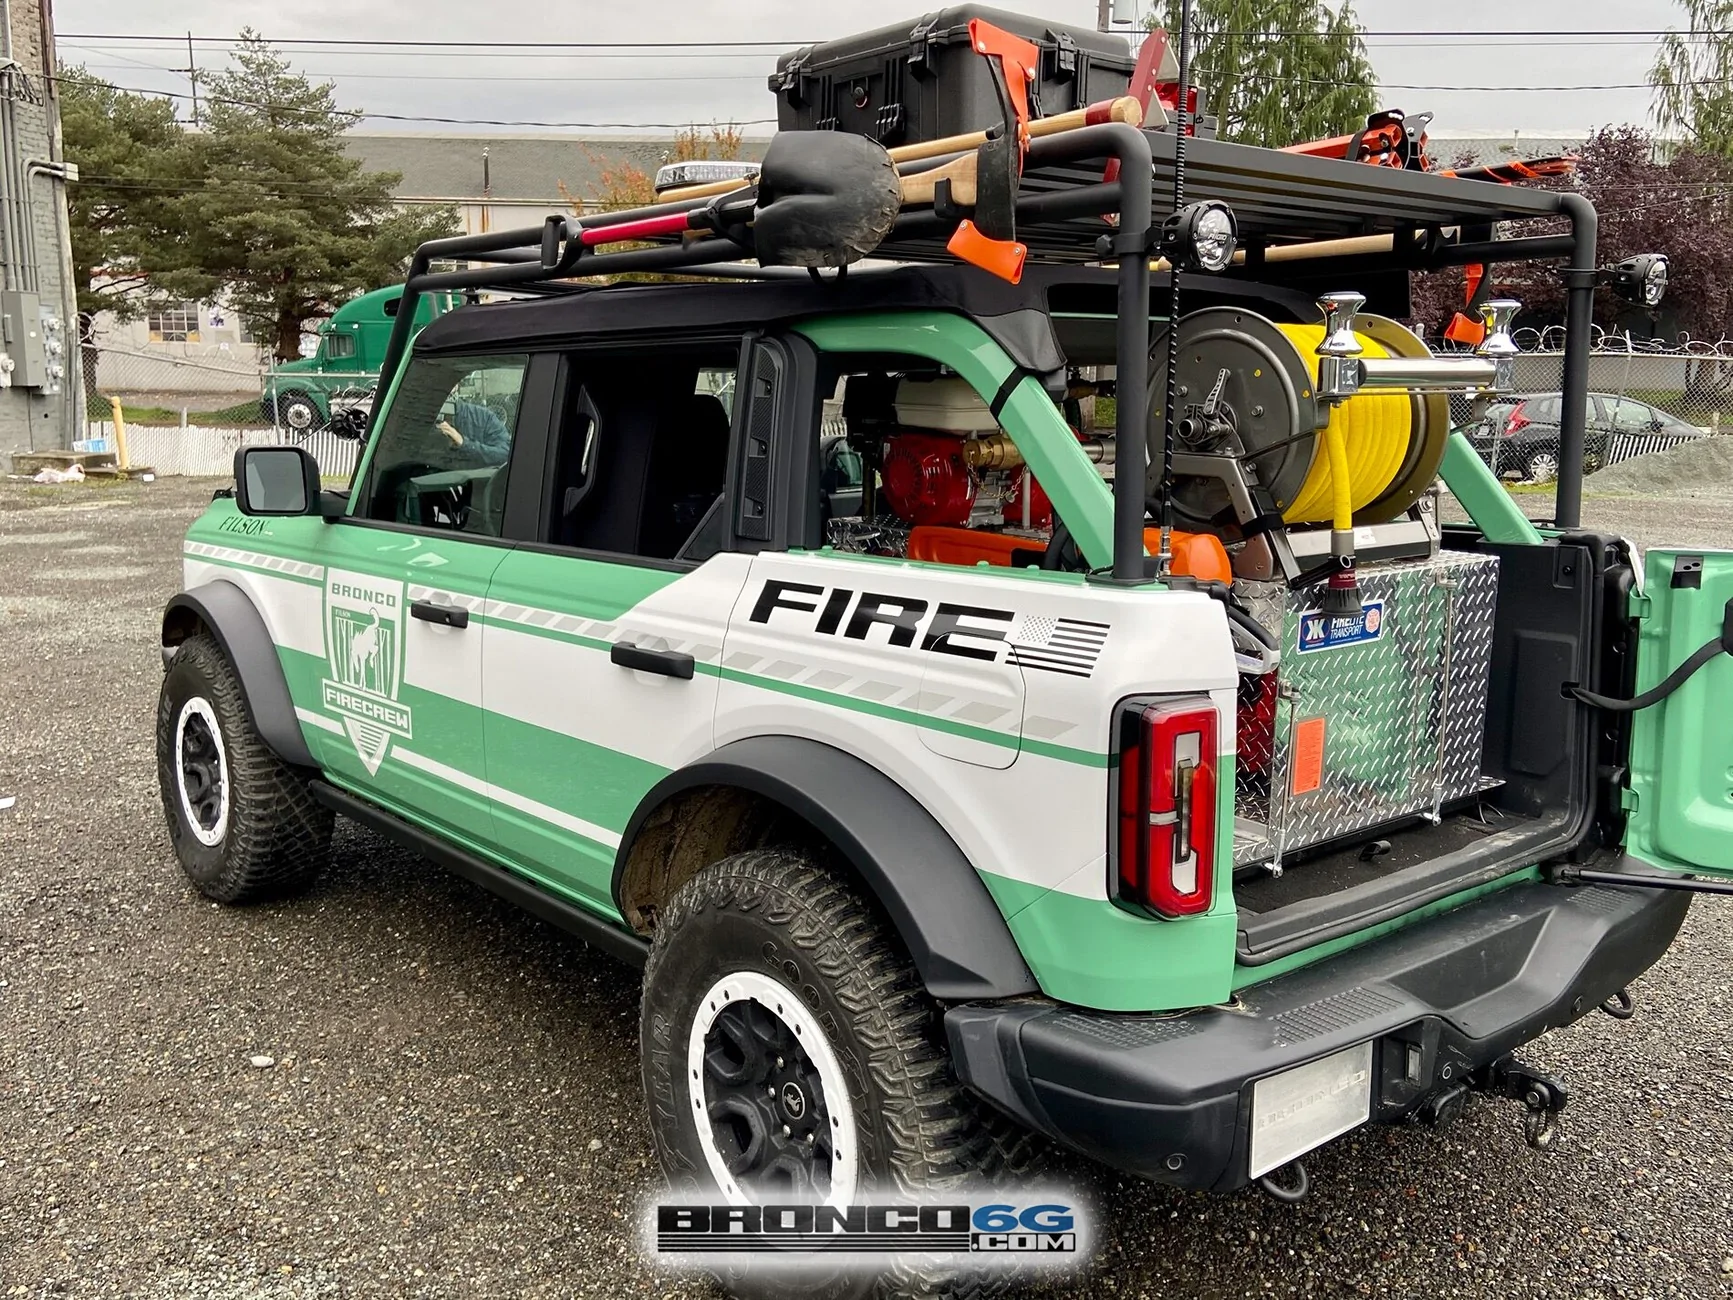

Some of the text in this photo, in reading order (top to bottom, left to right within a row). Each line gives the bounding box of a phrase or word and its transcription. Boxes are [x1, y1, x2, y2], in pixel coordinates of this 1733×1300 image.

[218, 516, 270, 535] FILSON
[332, 582, 396, 607] BRONCO
[749, 579, 1015, 662] FIRE
[1330, 625, 1363, 640] TRANSPORT
[325, 689, 409, 730] FIRECREW
